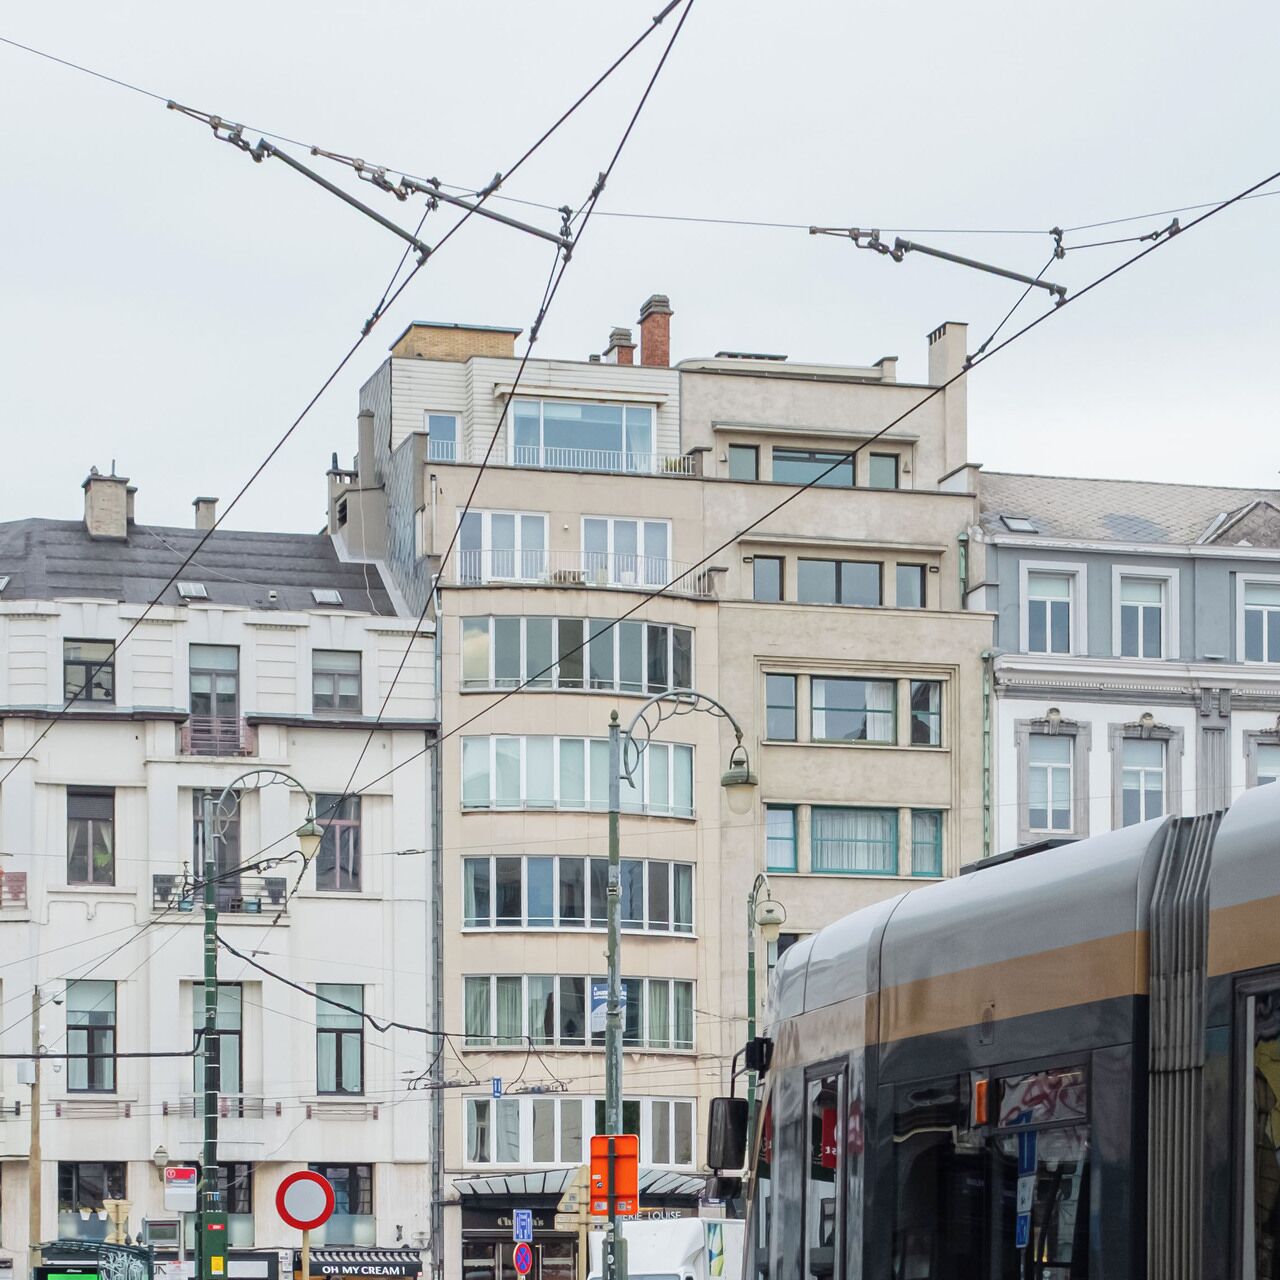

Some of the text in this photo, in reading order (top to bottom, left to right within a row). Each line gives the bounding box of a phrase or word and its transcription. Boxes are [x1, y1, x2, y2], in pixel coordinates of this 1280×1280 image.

[648, 1210, 682, 1221] LOUISE
[322, 1265, 339, 1274] OH
[342, 1265, 363, 1275] MY
[364, 1265, 400, 1275] CREAM
